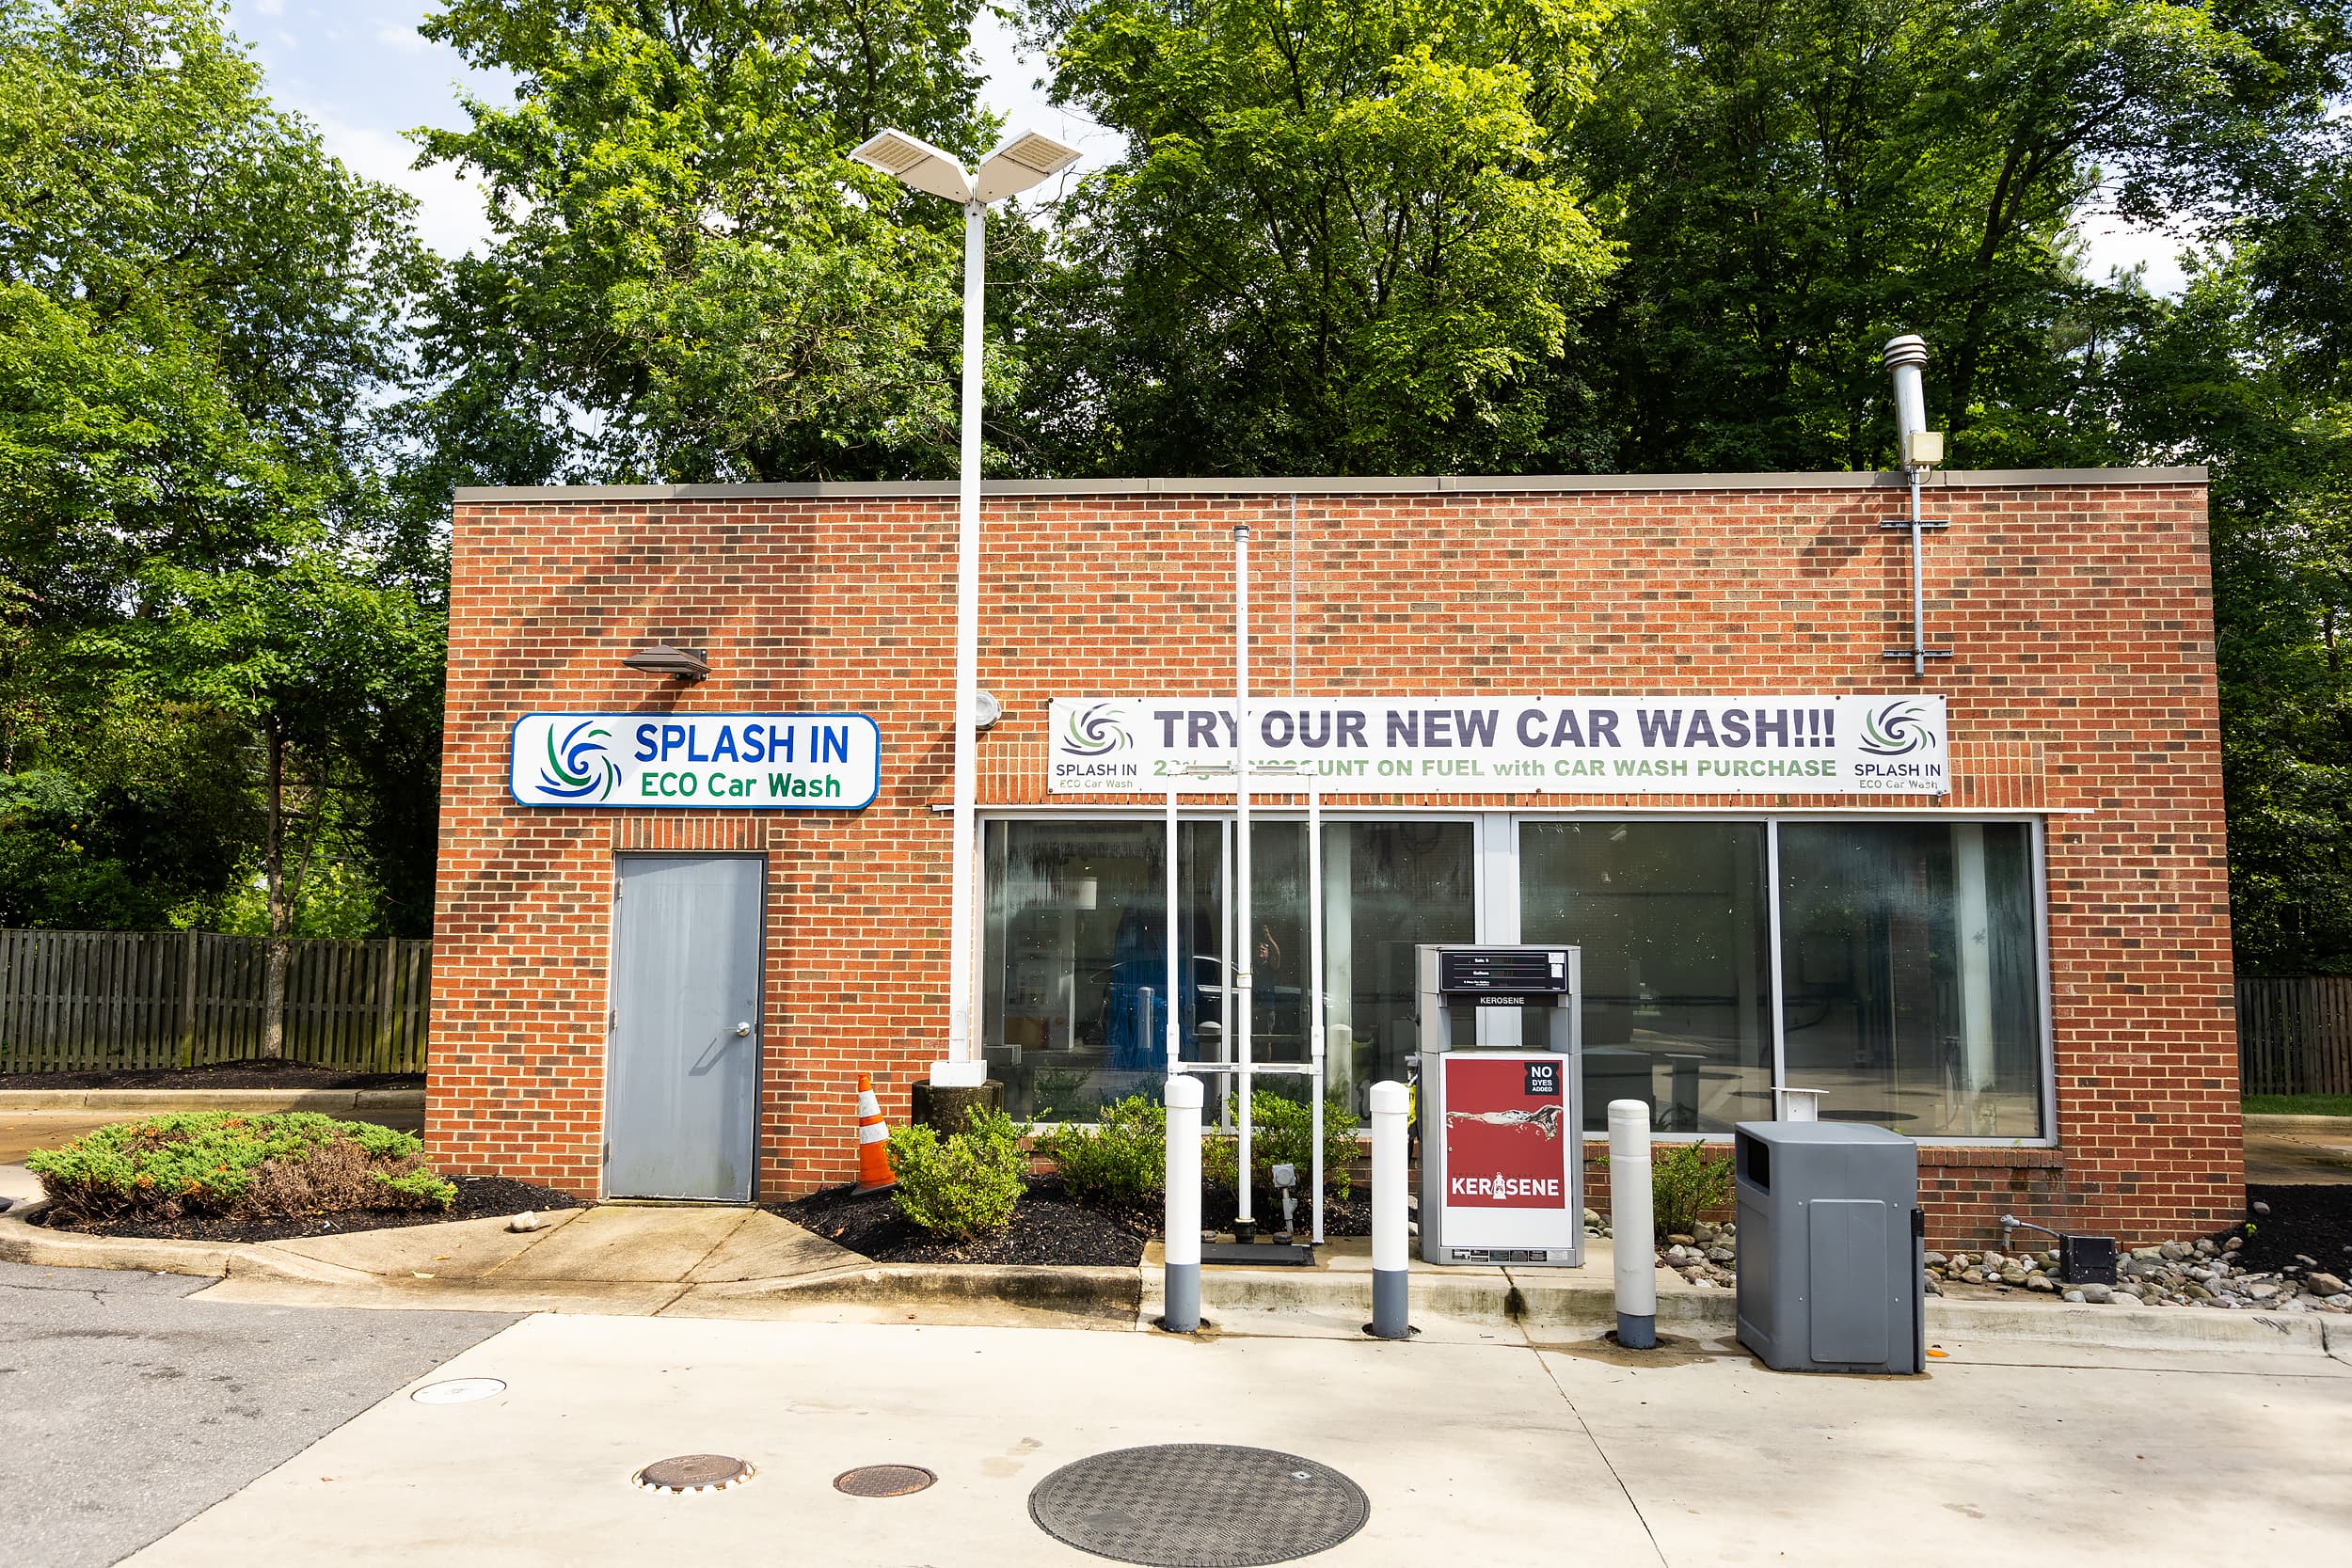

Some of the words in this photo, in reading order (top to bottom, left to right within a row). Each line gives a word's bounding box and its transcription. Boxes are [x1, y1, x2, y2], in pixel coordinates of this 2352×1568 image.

[1154, 711, 1252, 748] TRY
[1262, 711, 1368, 748] OUR
[1387, 710, 1499, 747] NEW
[1518, 709, 1621, 747] CAR
[1637, 709, 1835, 748] WASH!!!
[634, 724, 794, 763] SPLASH
[811, 726, 848, 763] IN
[1057, 764, 1116, 776] SPLASH
[1122, 764, 1136, 775] IN
[1378, 760, 1411, 776] ON
[1422, 760, 1485, 776] FUEL
[1493, 760, 1544, 776] with
[1555, 760, 1605, 776] CAR
[1613, 760, 1687, 776] WASH
[1698, 760, 1836, 776] PURCHASE
[1854, 764, 1919, 776] SPLASH
[1926, 764, 1940, 776] IN
[642, 772, 697, 796] ECO
[708, 773, 756, 797] Car
[769, 773, 840, 797] Wash
[1860, 780, 1882, 788] ECO
[1886, 780, 1904, 788] Car
[1909, 780, 1938, 789] Wash
[1532, 1067, 1552, 1078] NO
[1452, 1176, 1559, 1197] KERSENE
